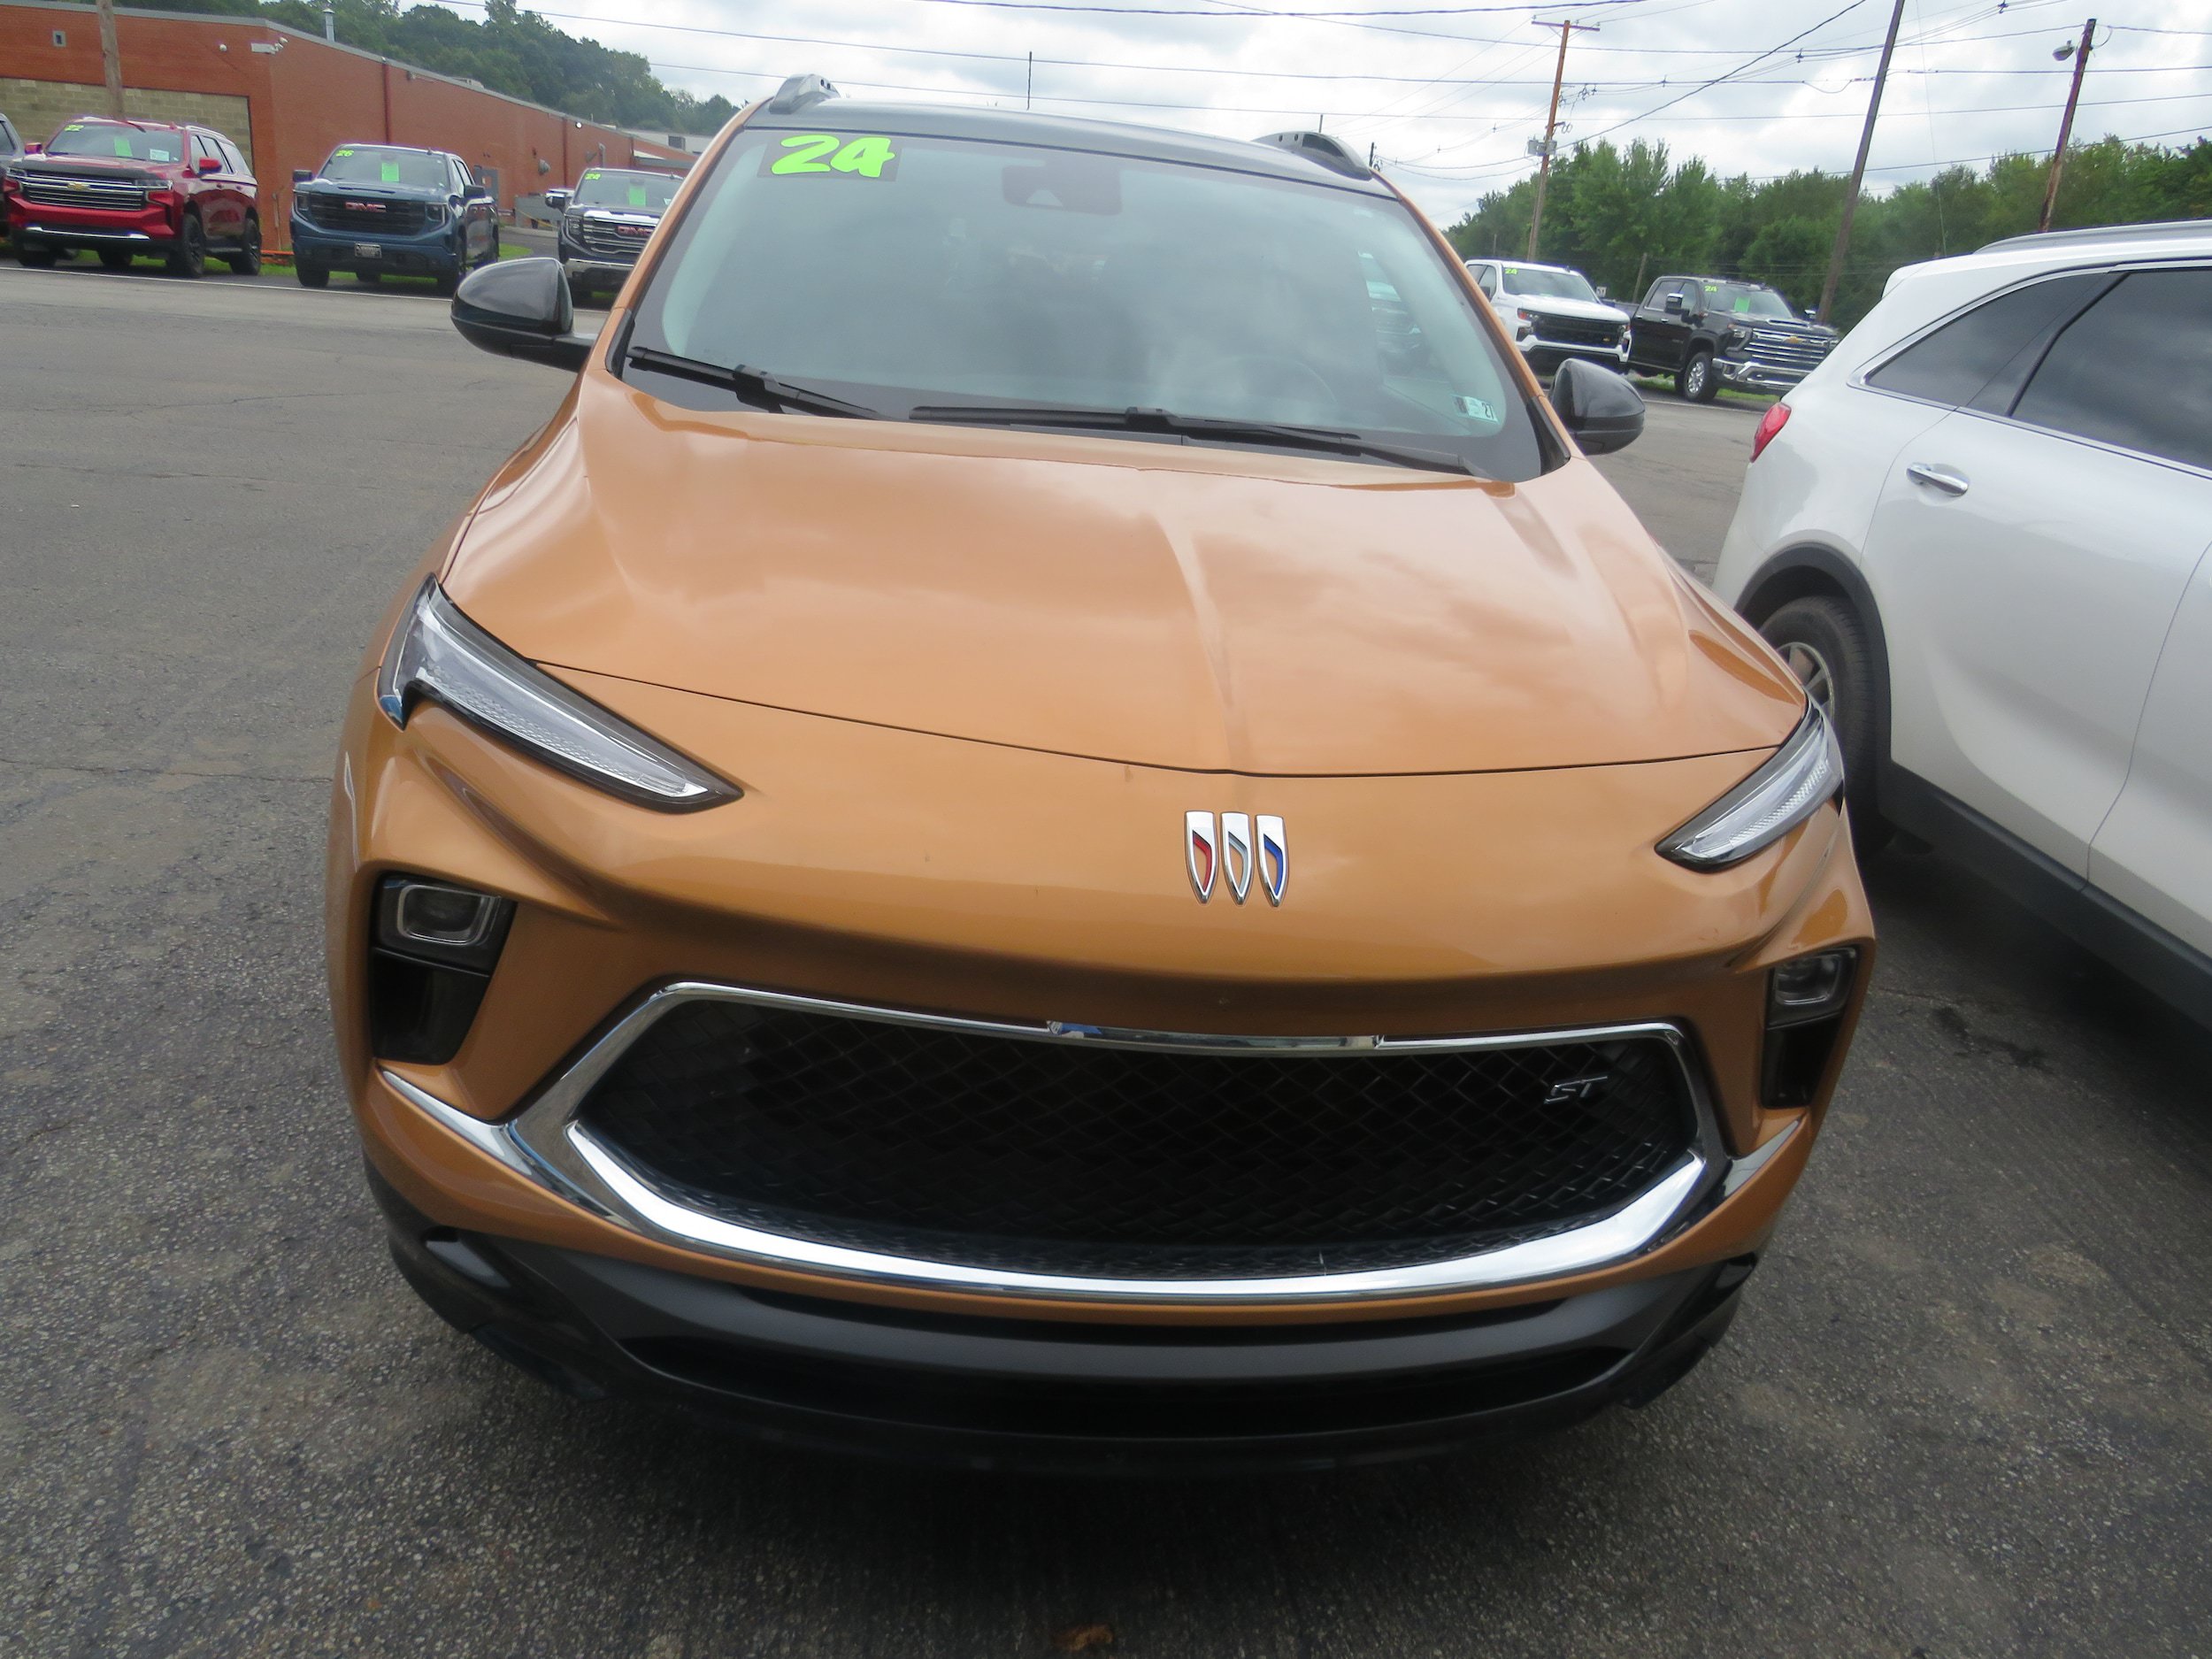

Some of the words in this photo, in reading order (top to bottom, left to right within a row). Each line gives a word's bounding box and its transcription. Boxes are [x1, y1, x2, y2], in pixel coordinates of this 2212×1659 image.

[771, 134, 895, 178] 24
[345, 202, 387, 212] GMC
[1481, 402, 1494, 419] 27
[1543, 1075, 1609, 1105] ST
